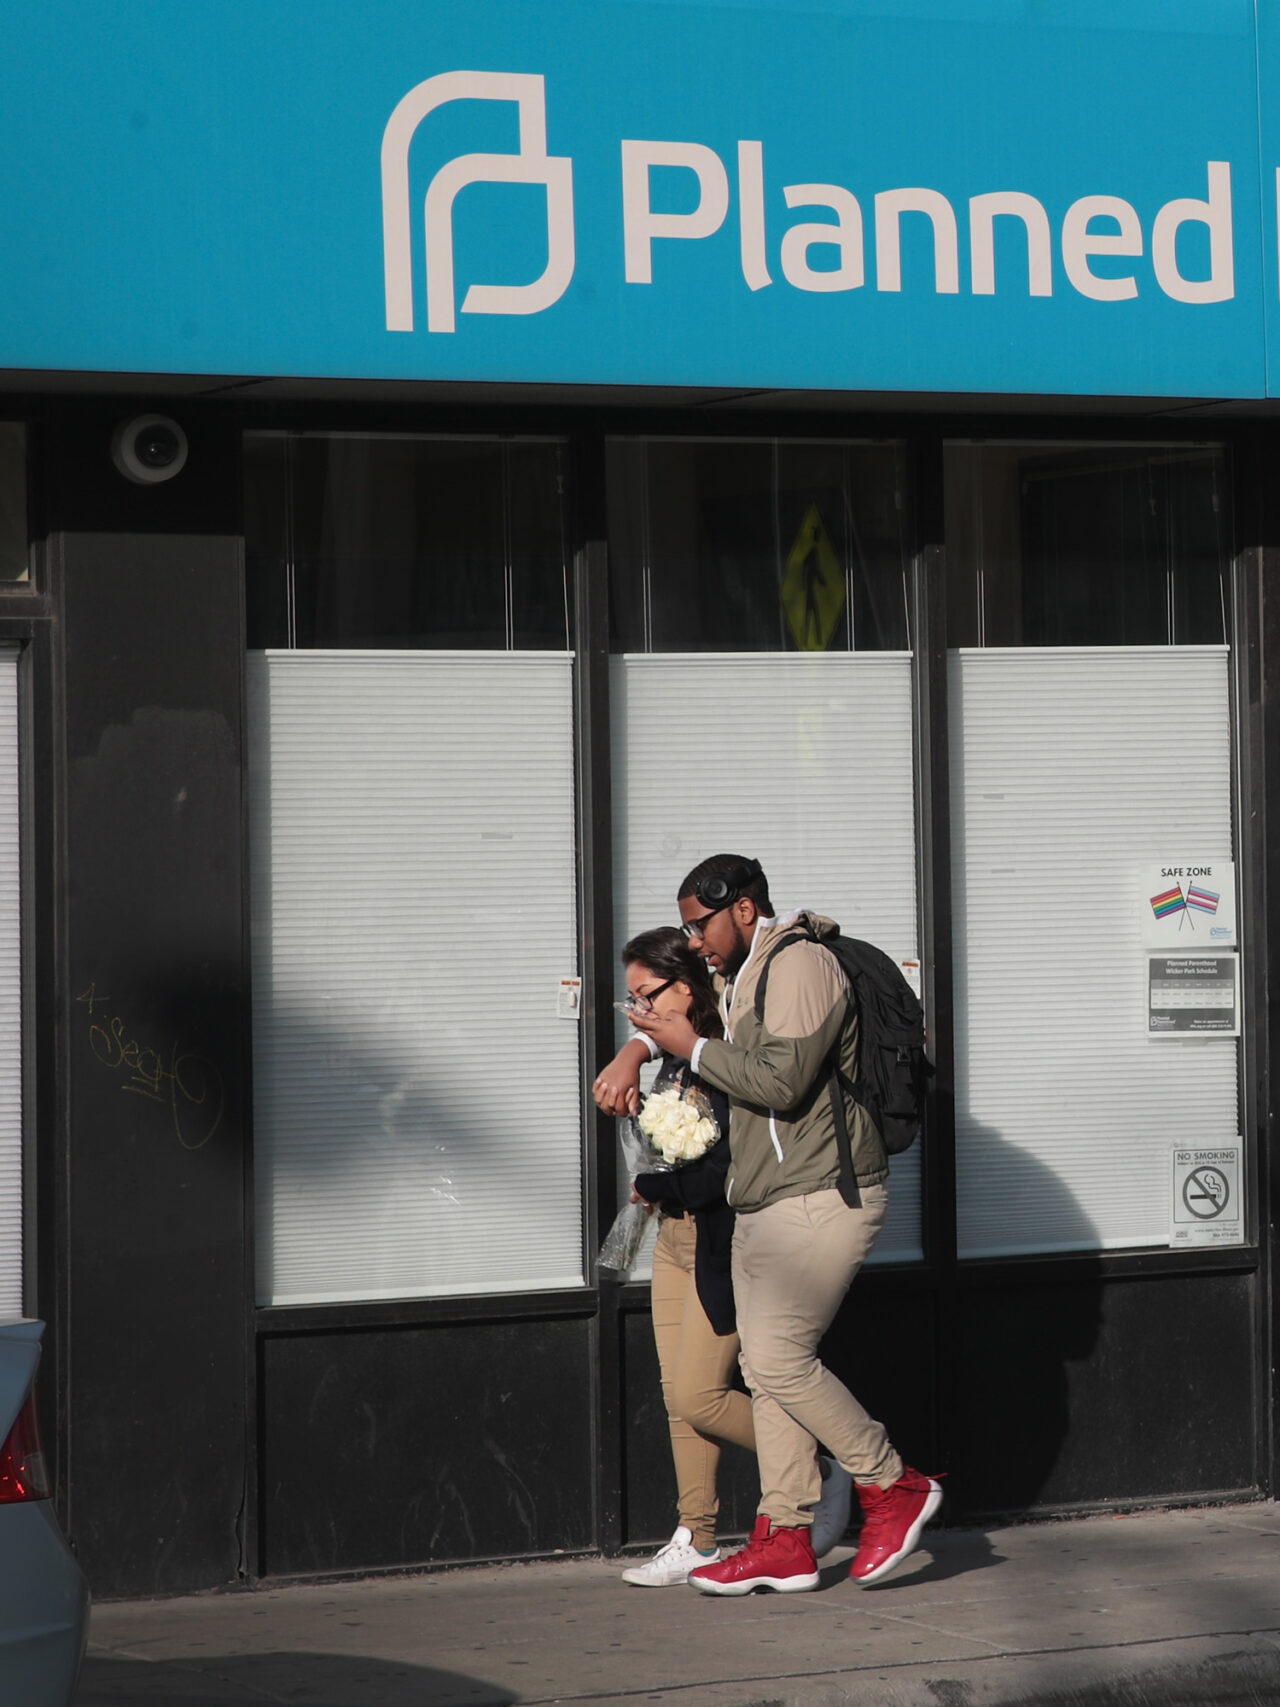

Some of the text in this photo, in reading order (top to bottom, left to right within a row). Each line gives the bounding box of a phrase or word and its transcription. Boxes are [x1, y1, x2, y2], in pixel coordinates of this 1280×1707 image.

[622, 139, 1235, 304] Planned
[1161, 867, 1212, 877] SAFE ZONE
[1177, 1151, 1235, 1160] NO SMOKING
